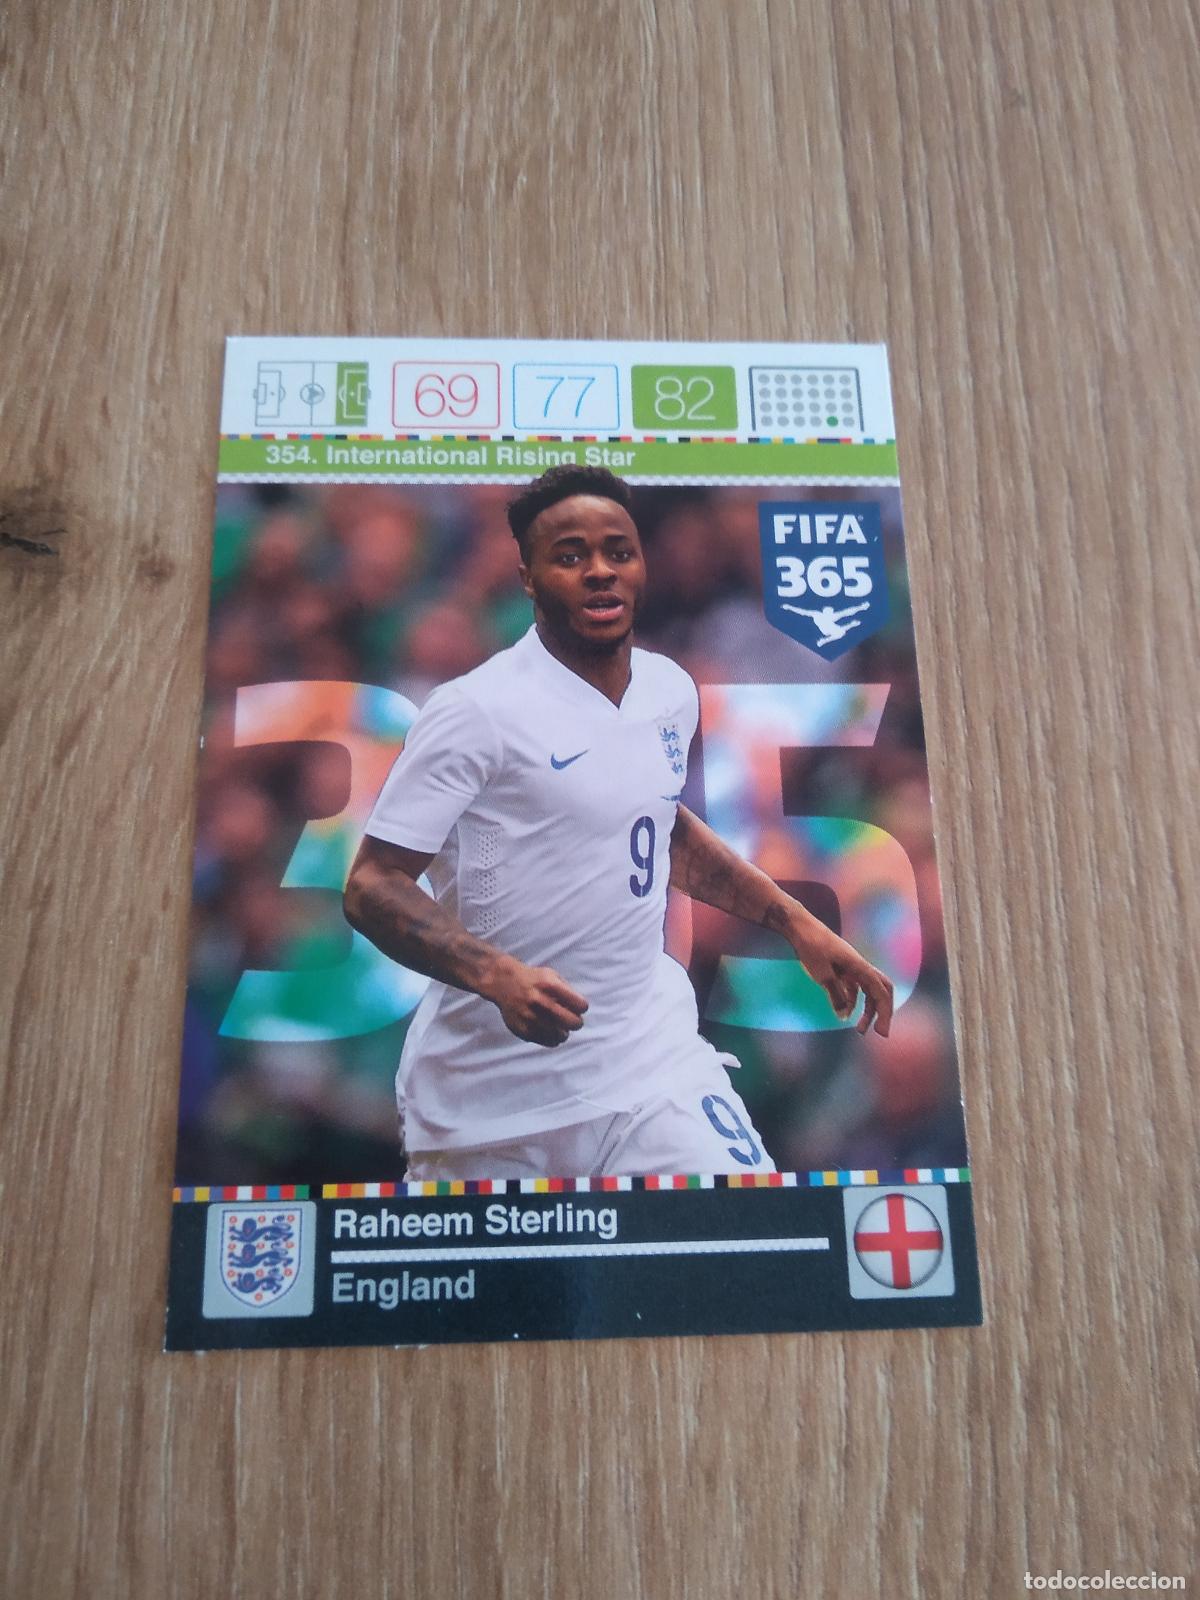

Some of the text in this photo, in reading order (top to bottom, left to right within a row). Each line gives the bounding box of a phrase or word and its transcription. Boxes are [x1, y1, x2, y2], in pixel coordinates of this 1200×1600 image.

[414, 373, 479, 418] 69
[535, 376, 596, 418] 77
[654, 375, 716, 421] 82
[265, 445, 317, 465] 354.
[326, 445, 488, 466] International
[585, 447, 636, 467] Star
[775, 555, 873, 598] 365
[629, 815, 656, 898] 9
[701, 1094, 761, 1166] 9
[334, 1203, 618, 1239] Raheem Sterling
[332, 1269, 476, 1310] England
